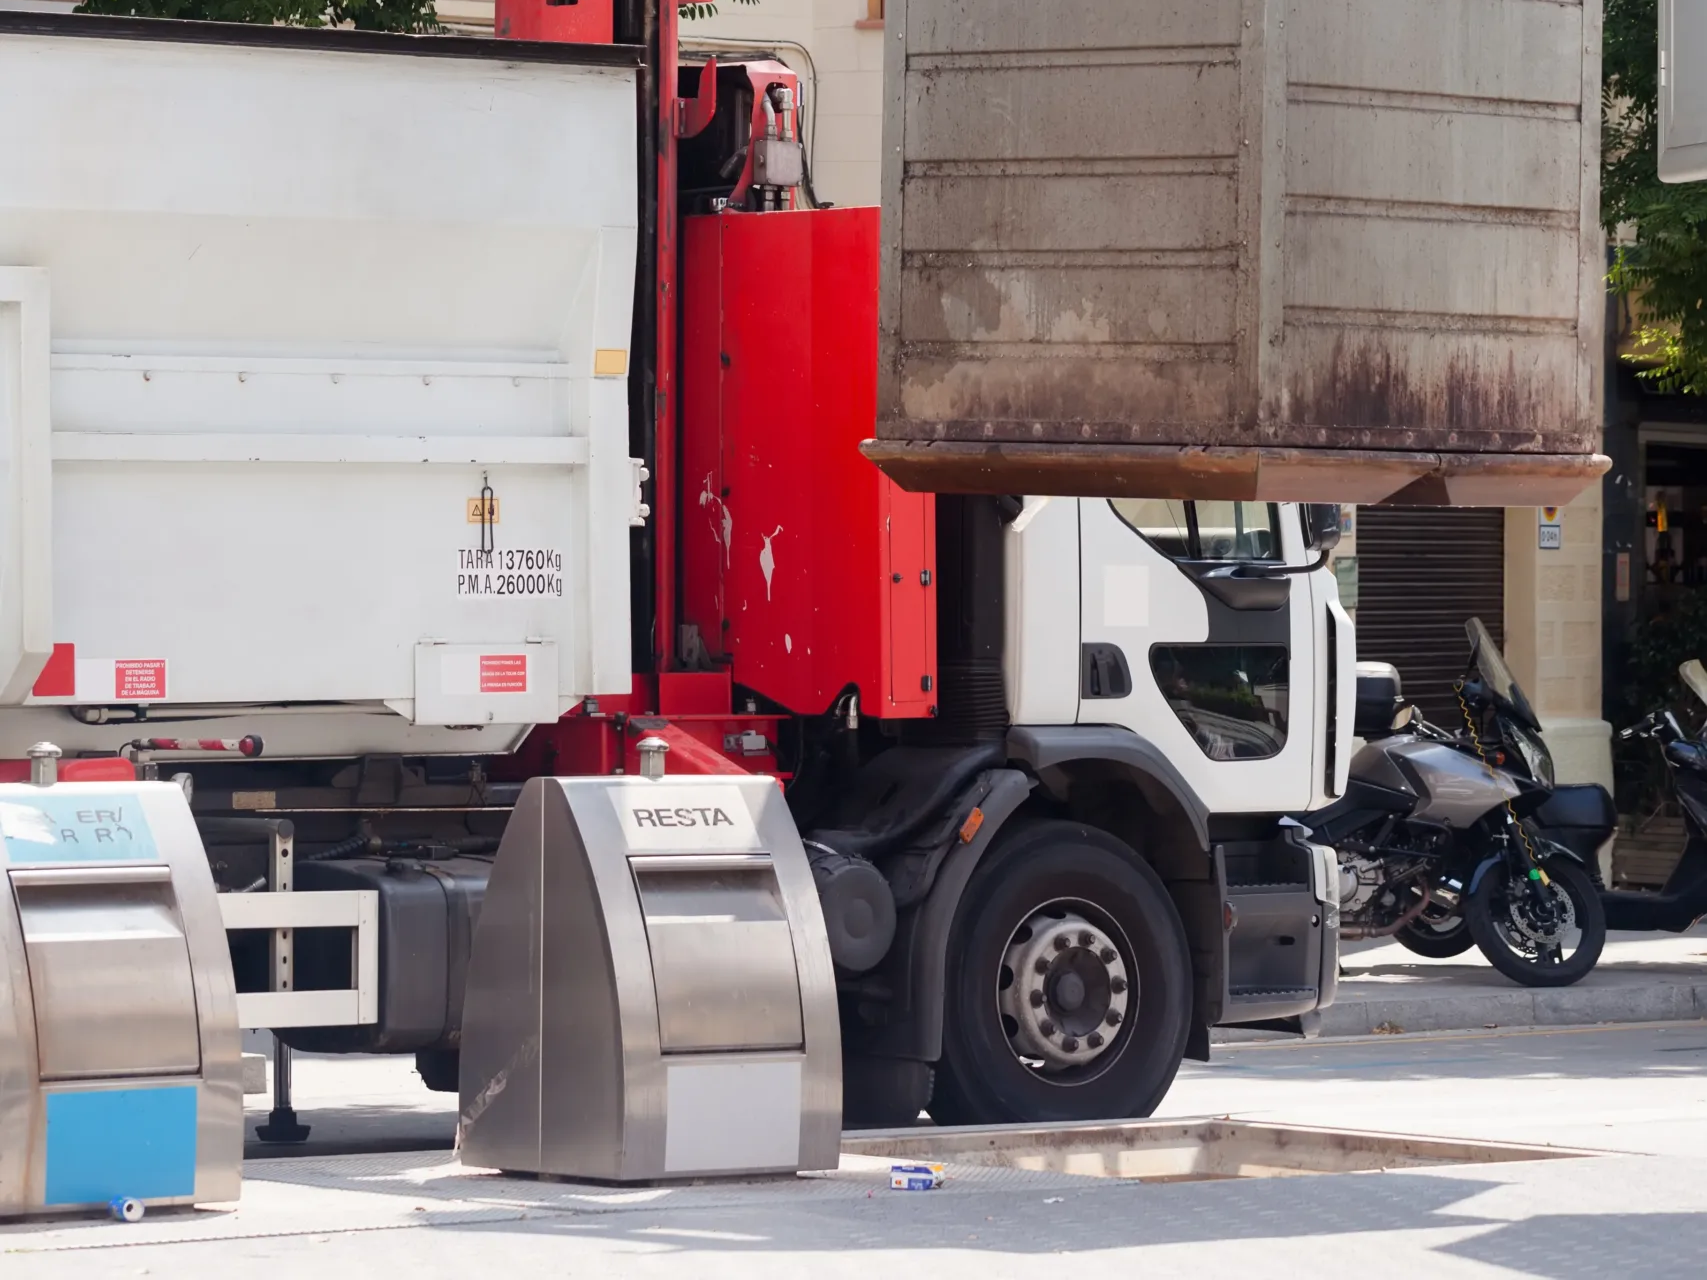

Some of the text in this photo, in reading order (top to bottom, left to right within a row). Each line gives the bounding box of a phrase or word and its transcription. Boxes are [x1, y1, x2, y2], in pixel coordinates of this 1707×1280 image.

[458, 549, 494, 569] TARA
[136, 688, 160, 696] MÁQUINA
[632, 808, 735, 827] RESTA
